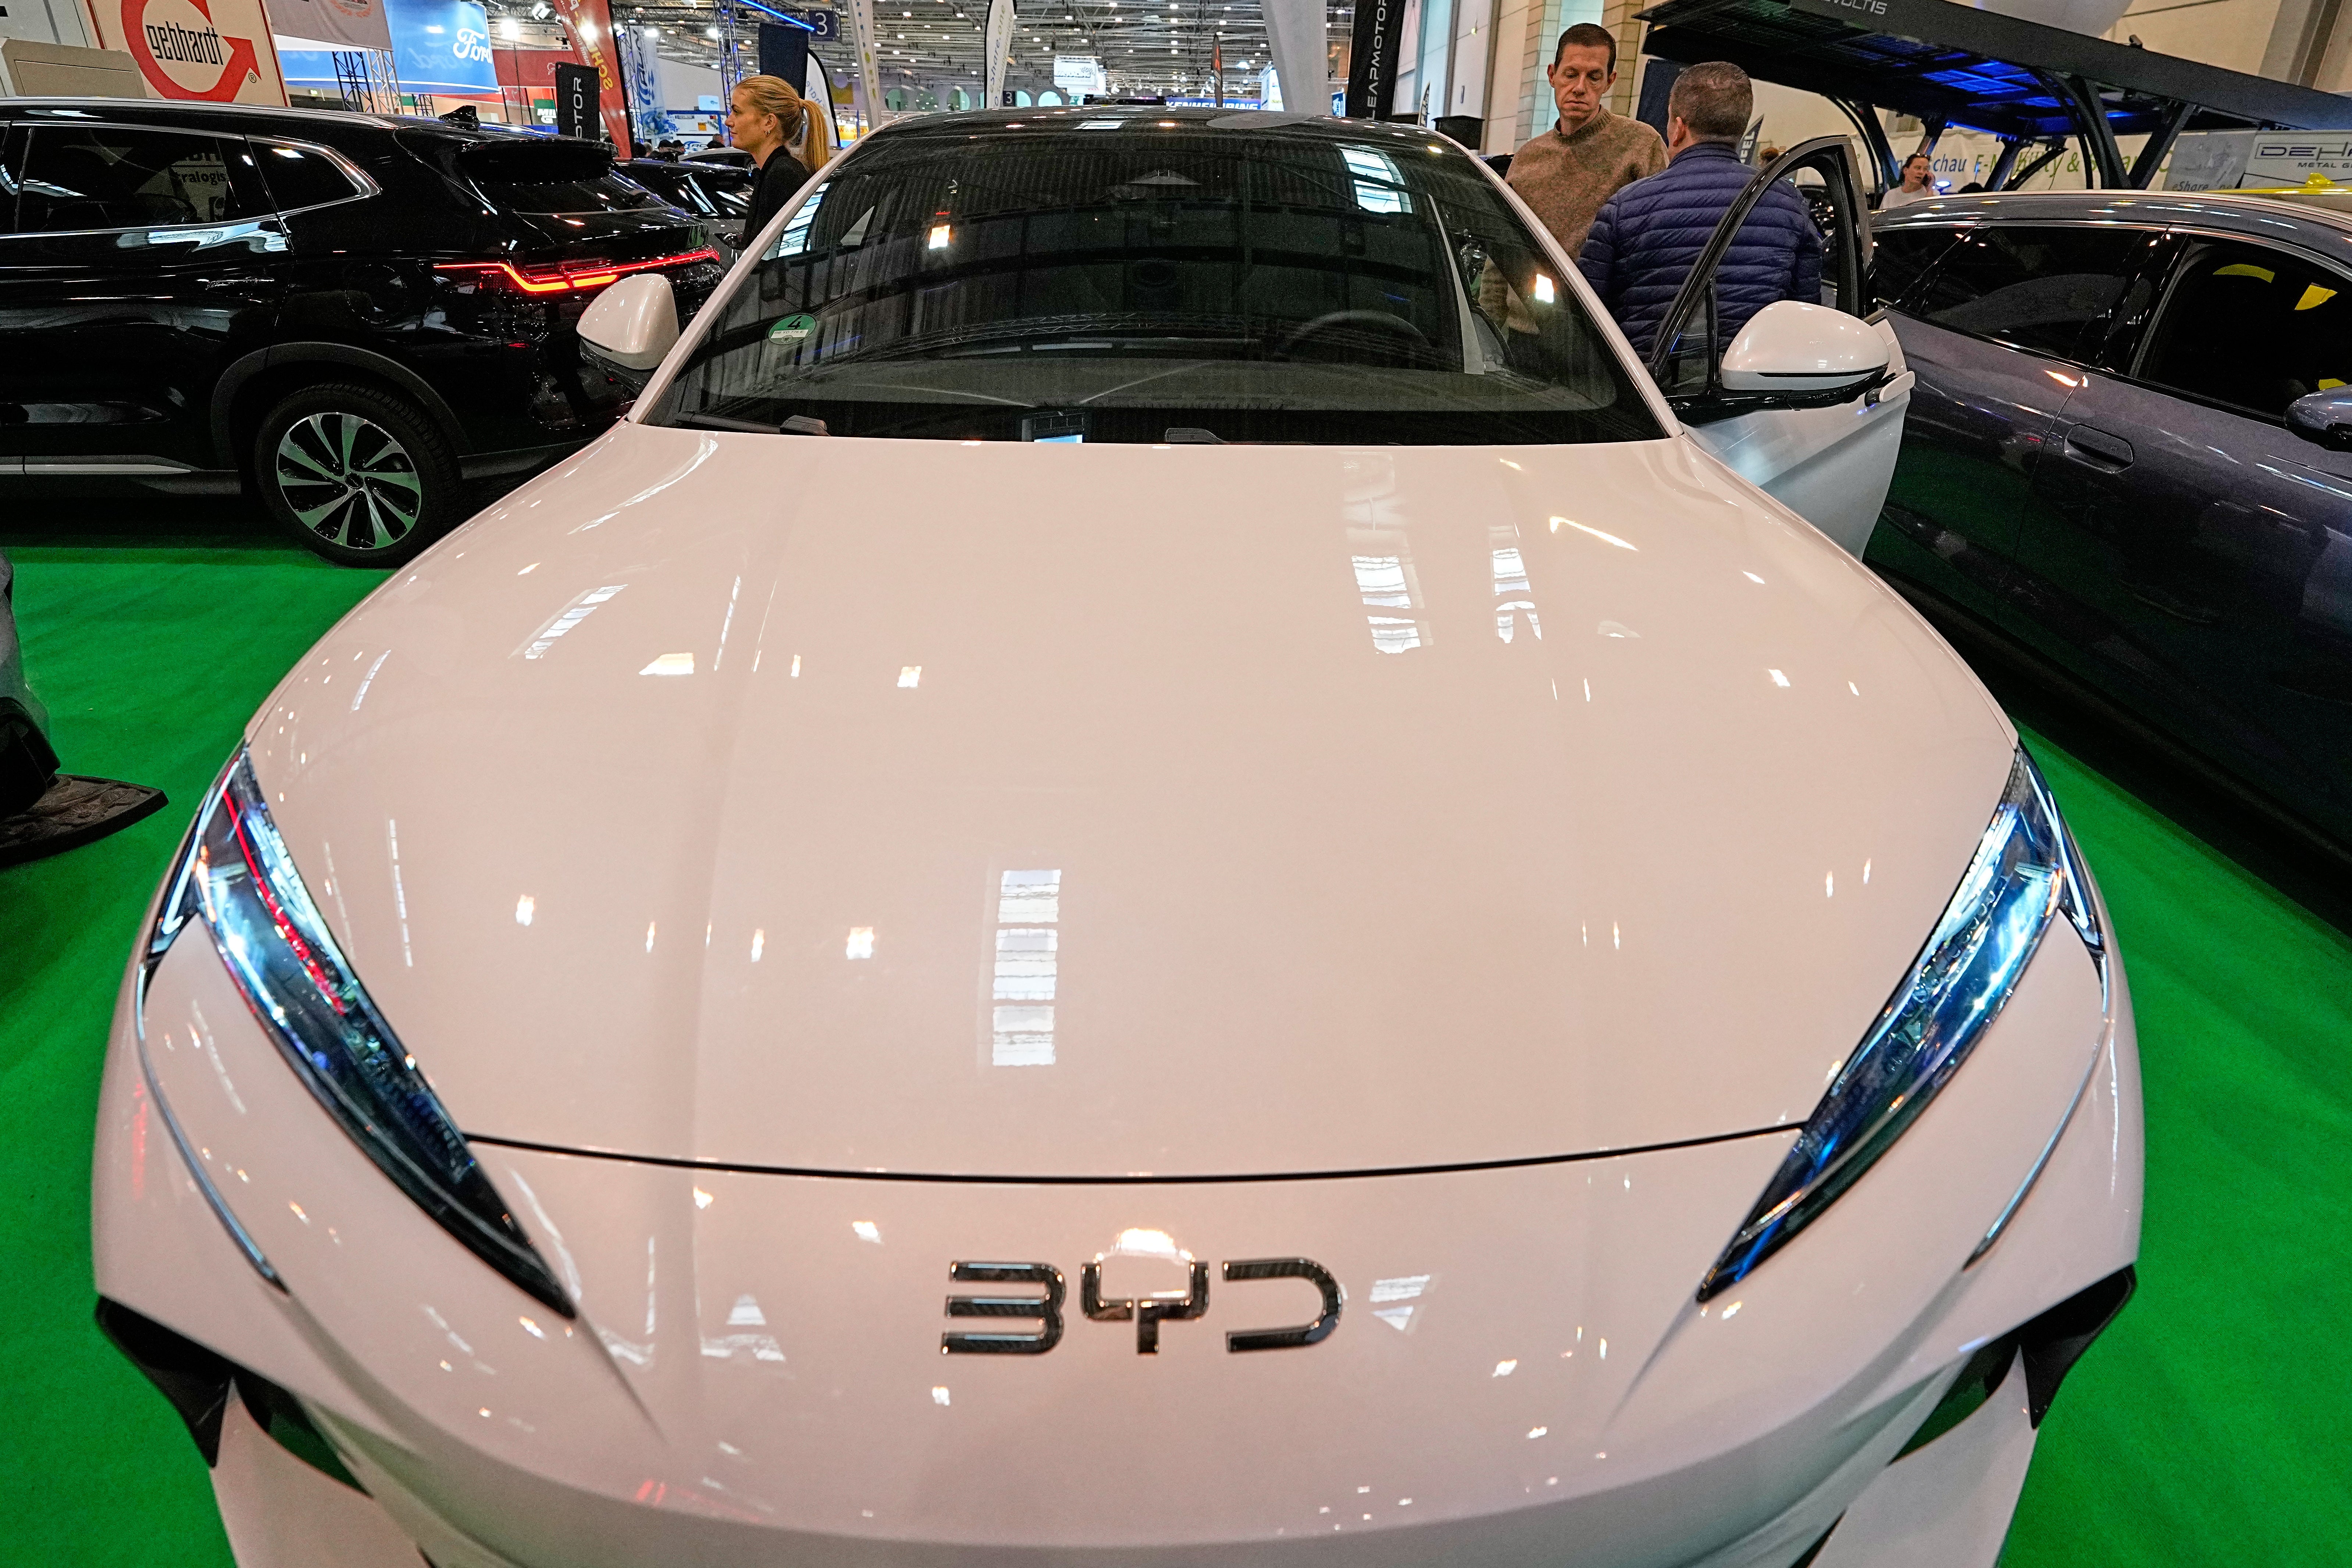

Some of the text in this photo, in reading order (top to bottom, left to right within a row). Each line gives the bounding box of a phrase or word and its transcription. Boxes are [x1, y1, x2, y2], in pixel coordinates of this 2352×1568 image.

[815, 13, 828, 35] 3
[146, 21, 224, 65] gebhardt
[453, 28, 493, 64] Ford
[1005, 92, 1012, 104] 3
[787, 316, 803, 329] 4
[941, 1257, 1343, 1355] BYD
